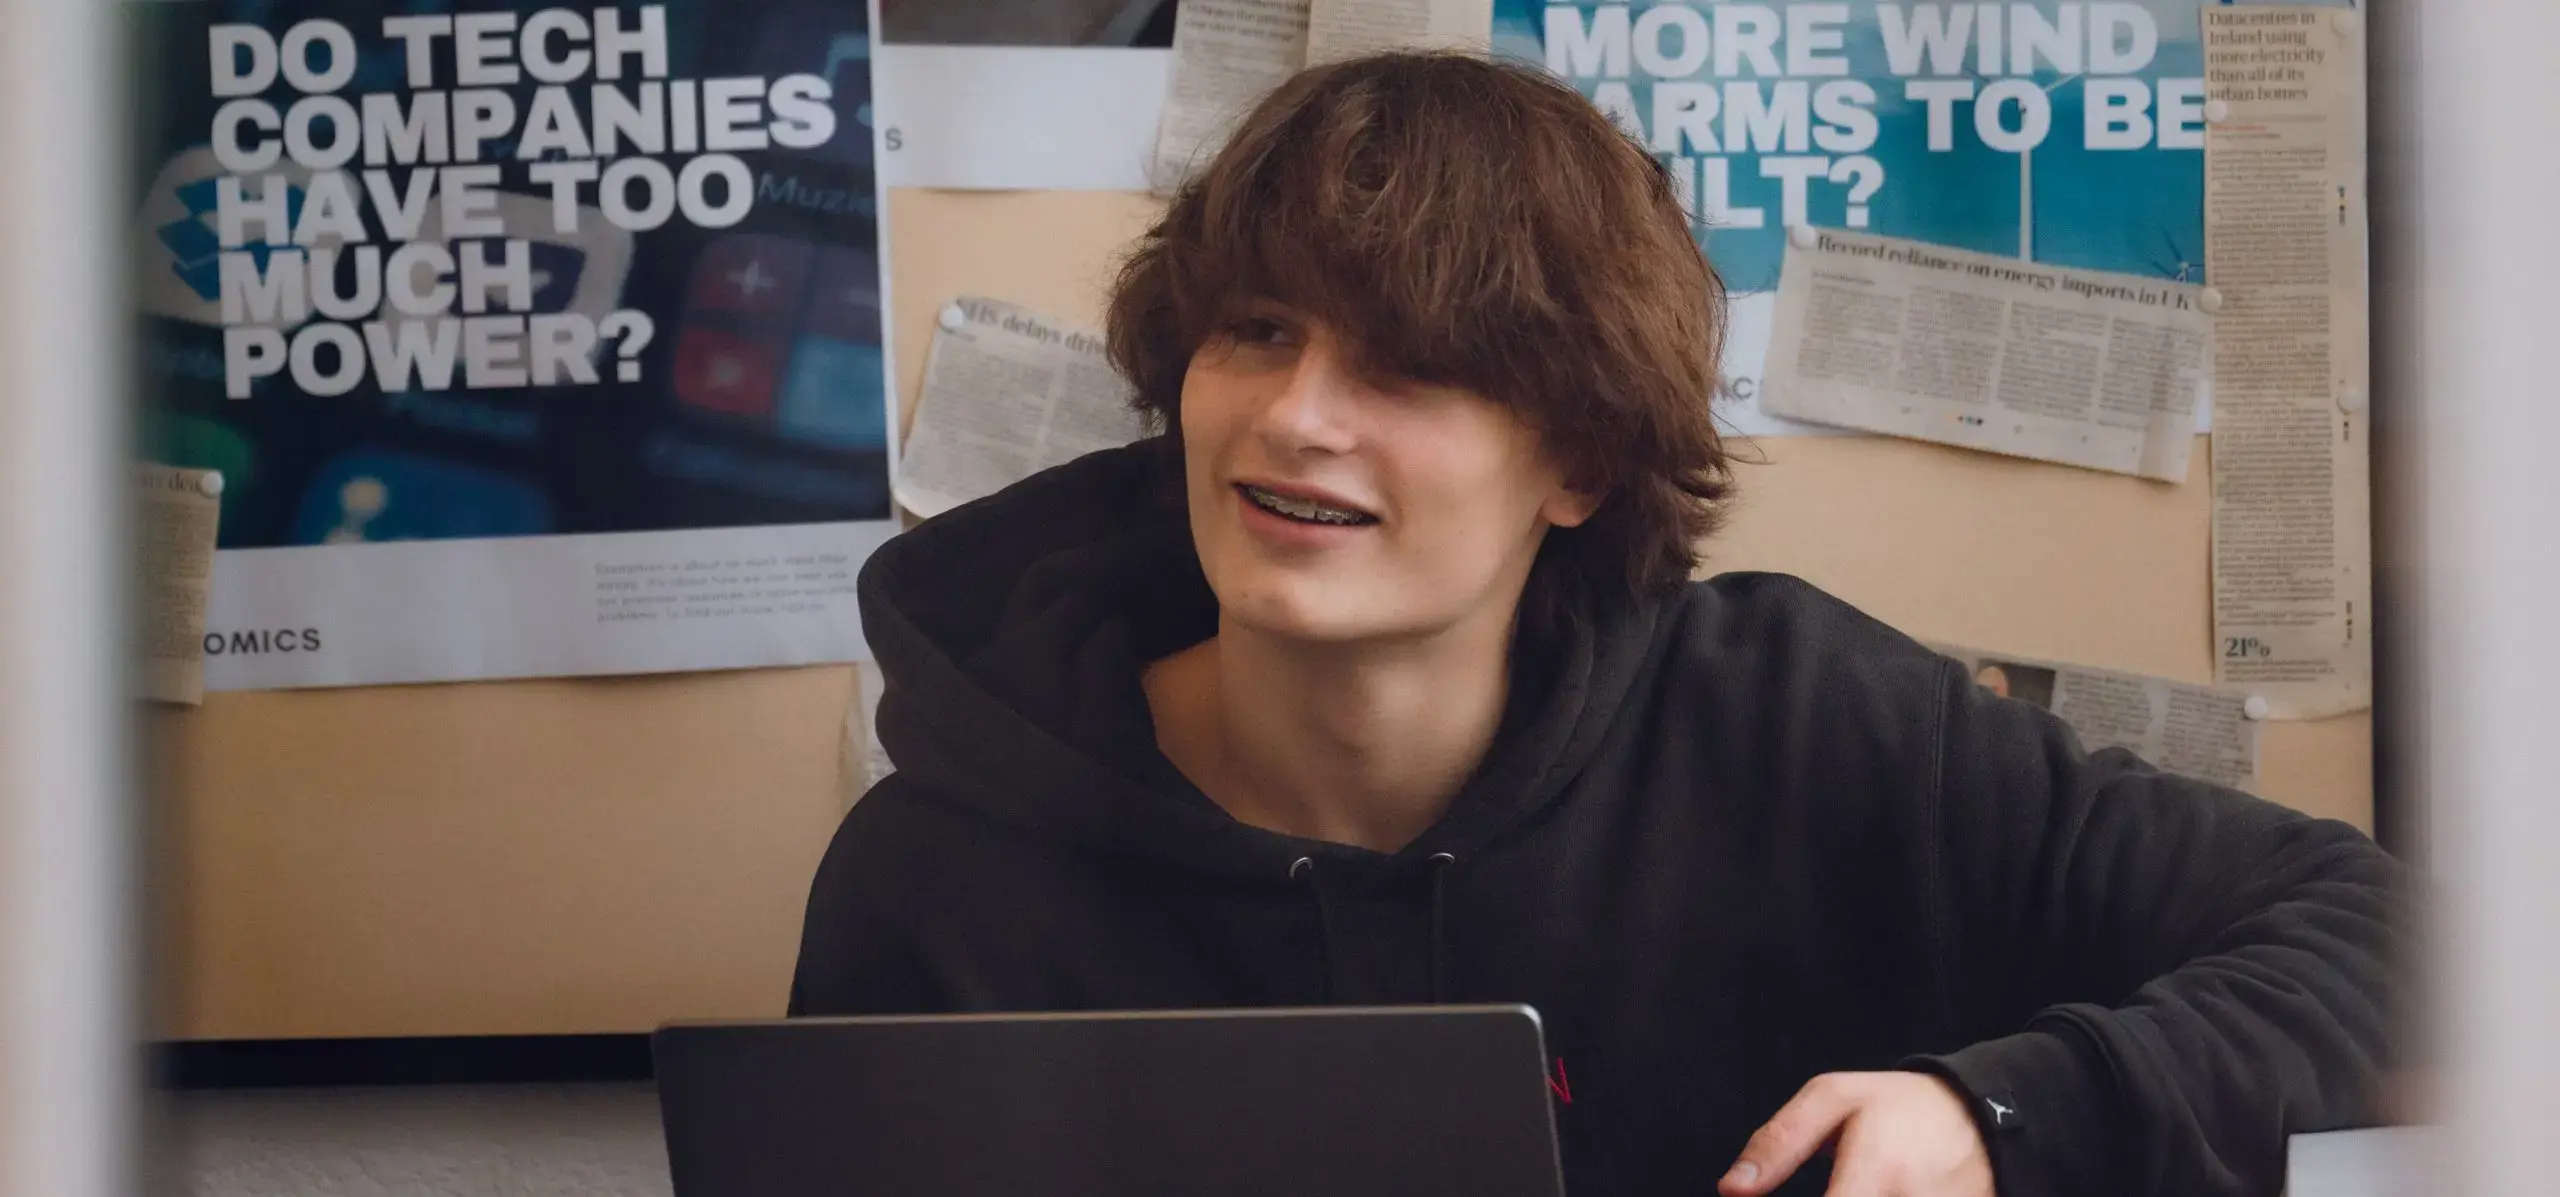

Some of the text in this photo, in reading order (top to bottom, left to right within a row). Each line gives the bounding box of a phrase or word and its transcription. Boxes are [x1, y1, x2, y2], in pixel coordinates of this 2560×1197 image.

[208, 4, 669, 97] DO TECH
[1544, 2, 2159, 78] MORE WIND
[2209, 68, 2246, 82] than
[2268, 67, 2285, 82] of
[2251, 48, 2326, 66] electricity
[210, 73, 837, 173] COMPANIES
[1591, 77, 2206, 154] ARMS TO BE
[215, 153, 754, 246] HAVE TOO
[1671, 155, 1884, 229] ILT?
[218, 239, 534, 323] MUCH
[1817, 234, 1885, 260] Record
[1966, 262, 1990, 278] on
[2061, 274, 2136, 300] imports
[223, 308, 656, 400] POWER?
[203, 628, 322, 655] OMICS
[2224, 636, 2272, 658] 21%
